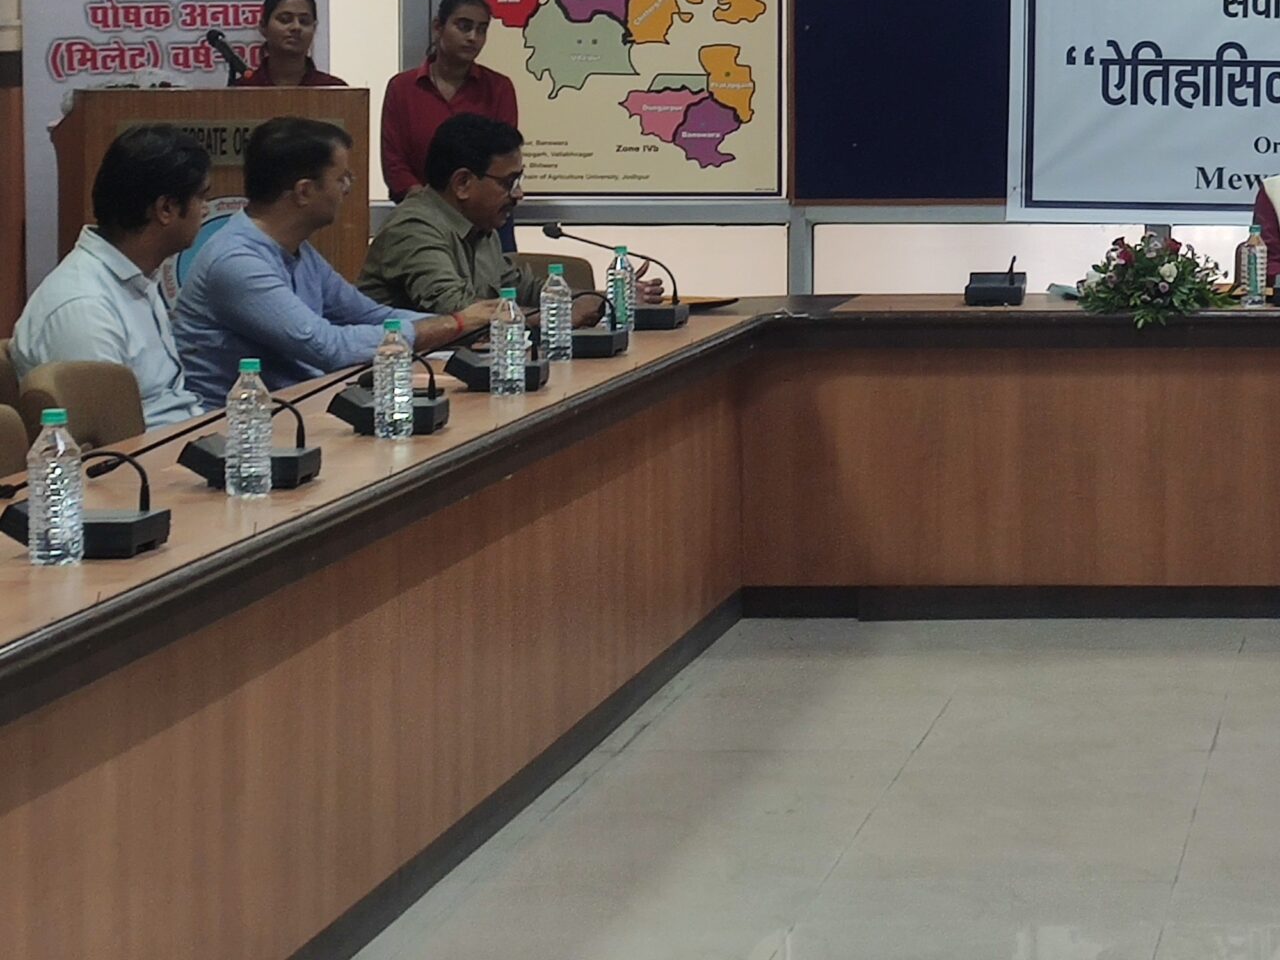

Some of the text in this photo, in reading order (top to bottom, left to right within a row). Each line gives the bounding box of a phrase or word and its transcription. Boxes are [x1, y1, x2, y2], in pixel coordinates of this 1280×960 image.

[50, 40, 162, 78] (मिलेट)
[616, 144, 659, 152] Zone IVb
